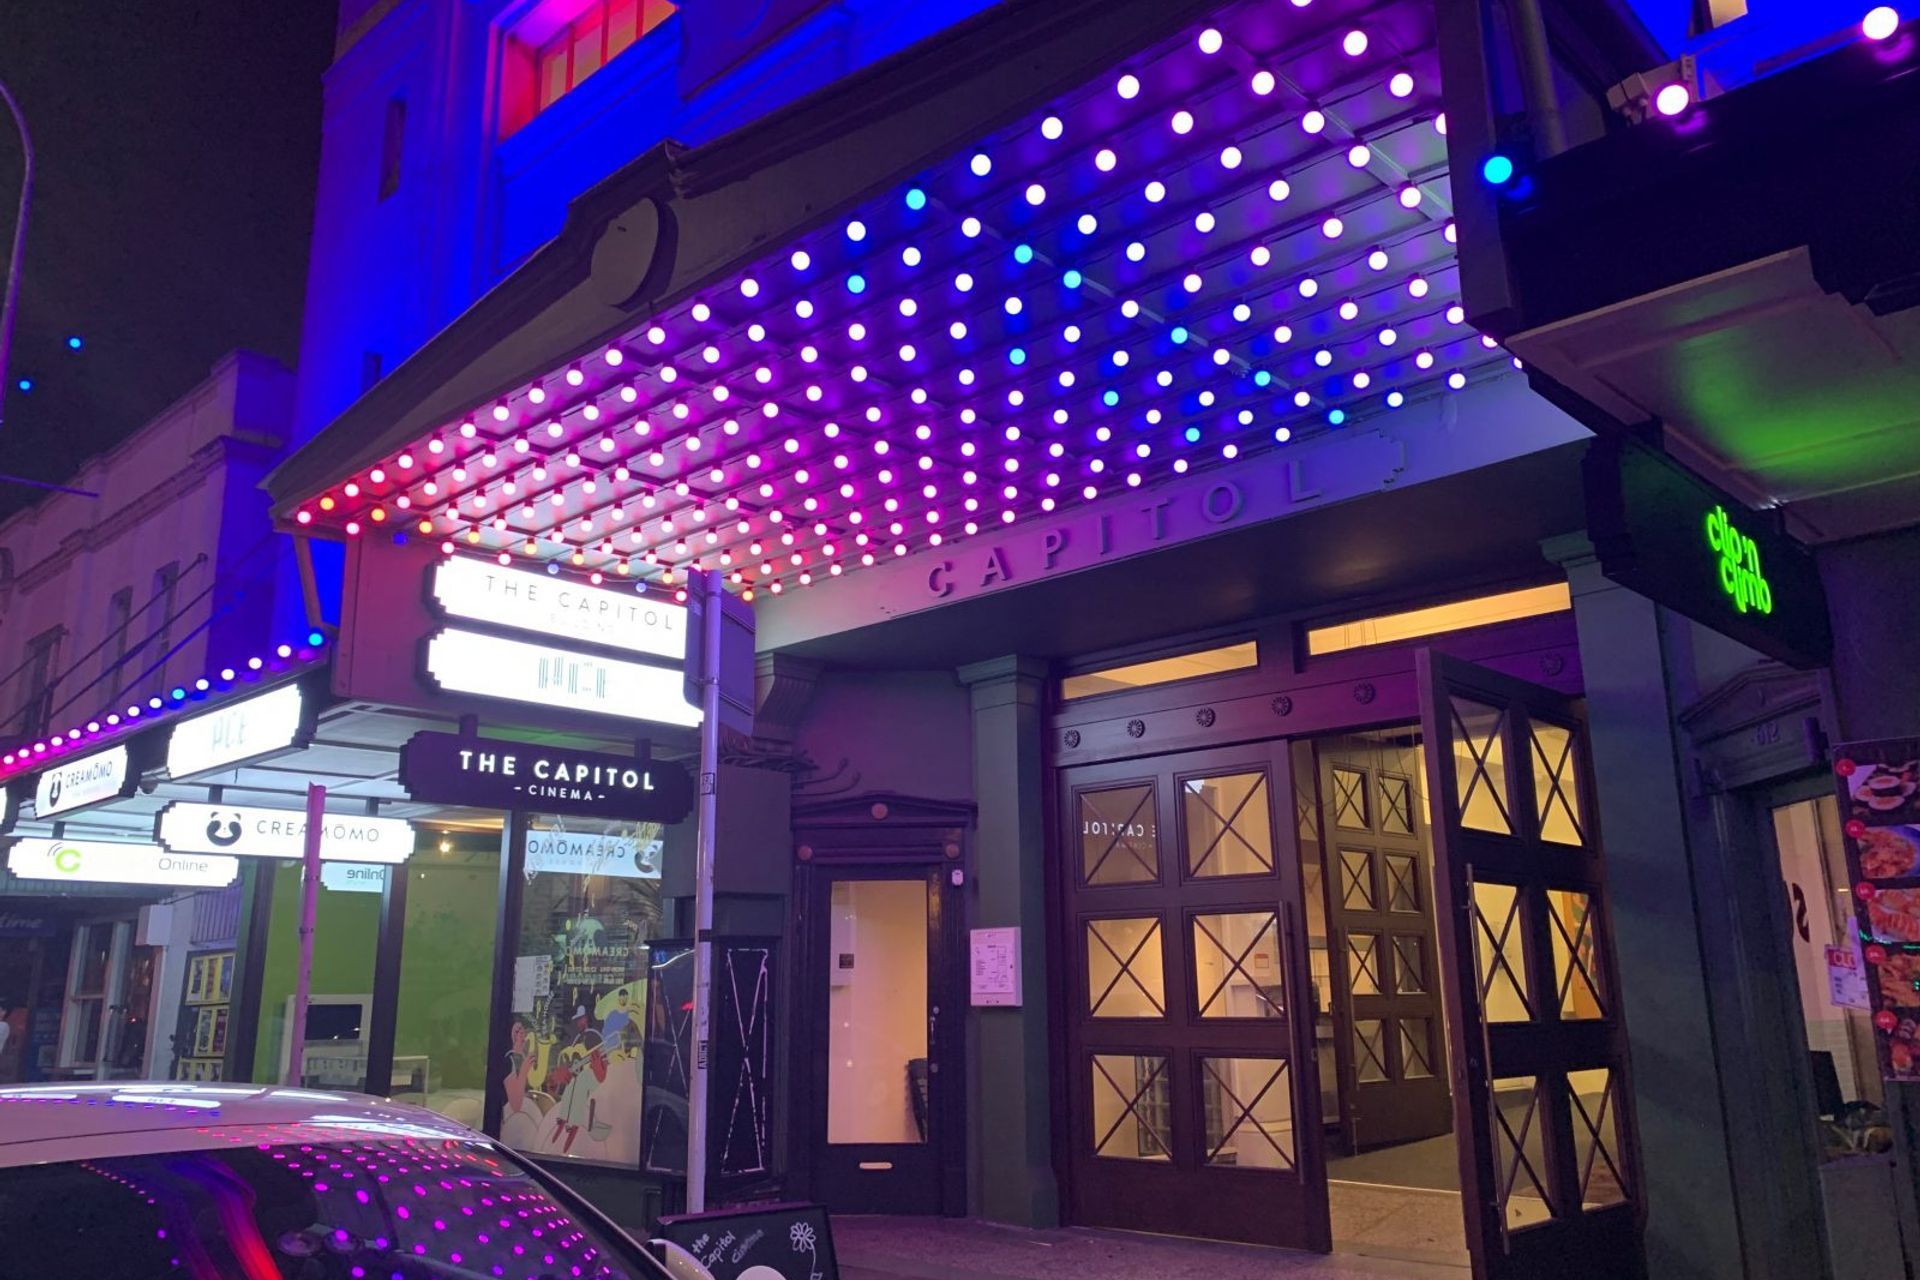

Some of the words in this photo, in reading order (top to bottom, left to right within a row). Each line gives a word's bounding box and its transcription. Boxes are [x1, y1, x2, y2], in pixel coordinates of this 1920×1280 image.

[928, 460, 1324, 599] CAPITOL
[485, 575, 537, 601] THE
[559, 591, 673, 630] CAPITOL
[459, 751, 516, 776] THE
[534, 760, 655, 790] CAPITOL
[528, 785, 593, 801] CINEMA
[158, 858, 208, 872] Online
